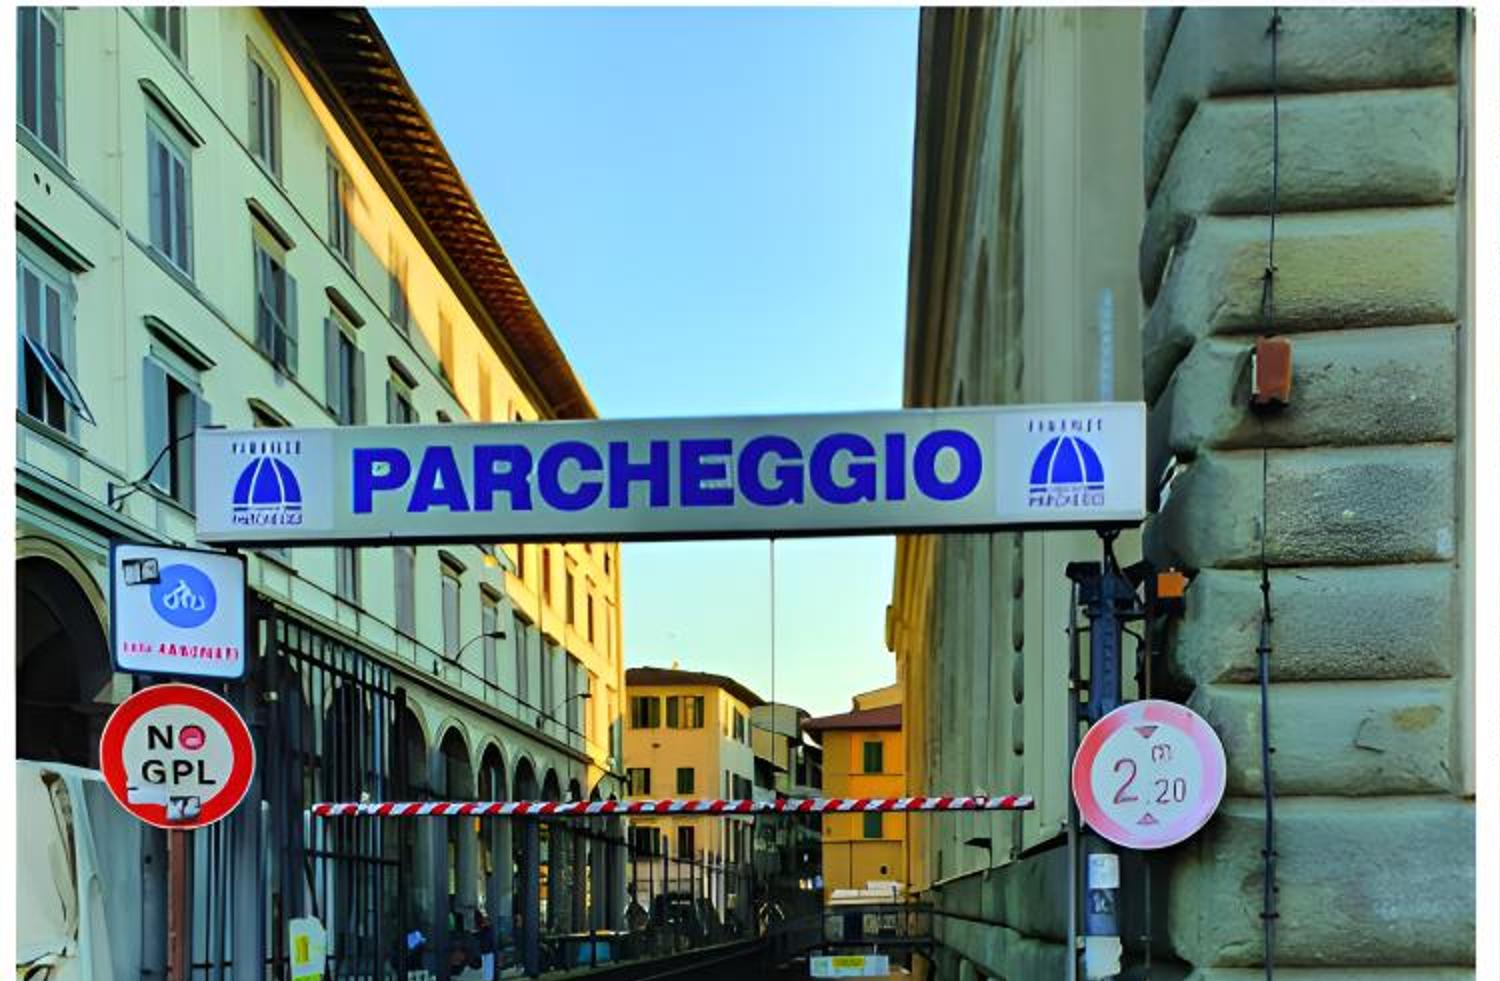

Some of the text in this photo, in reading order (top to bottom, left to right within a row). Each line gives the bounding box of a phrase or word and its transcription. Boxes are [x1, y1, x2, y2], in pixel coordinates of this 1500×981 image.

[352, 430, 983, 515] PARCHEGGIO
[147, 724, 206, 751] NO
[142, 759, 217, 785] GPL
